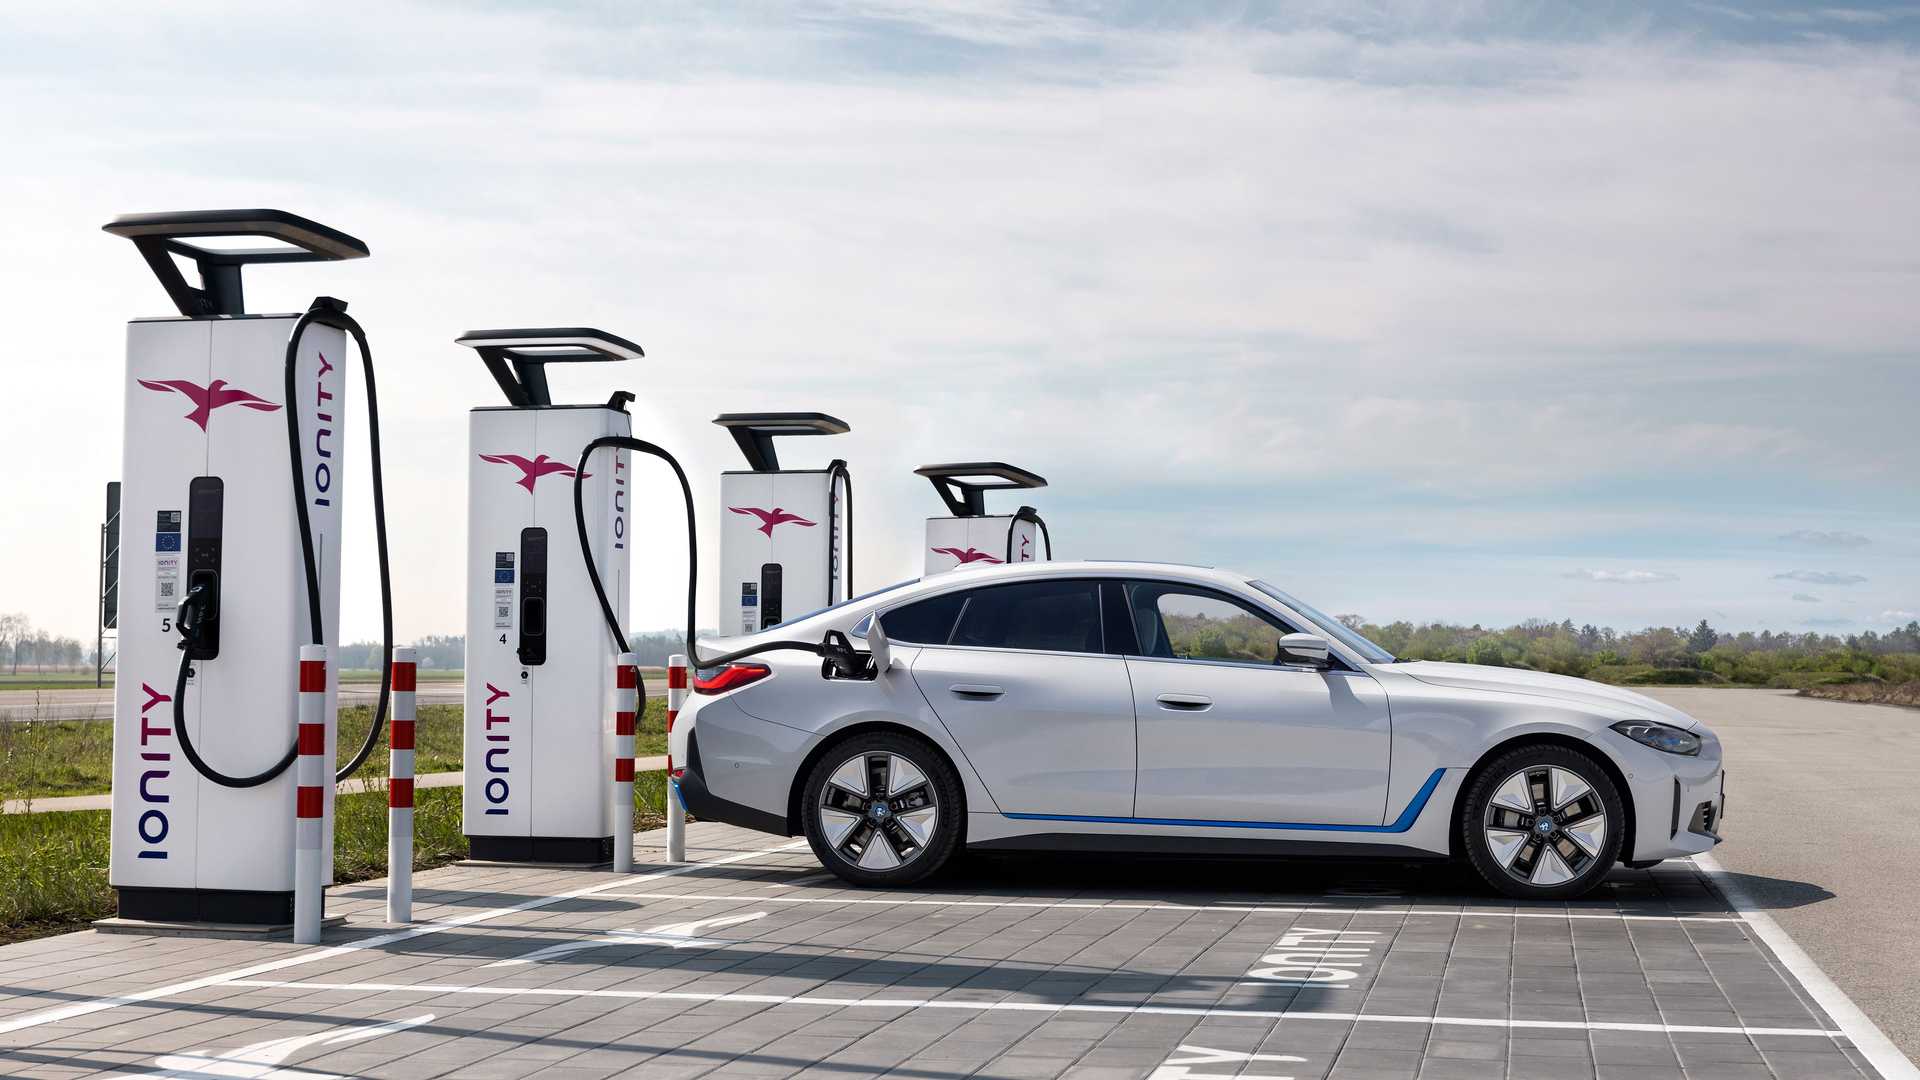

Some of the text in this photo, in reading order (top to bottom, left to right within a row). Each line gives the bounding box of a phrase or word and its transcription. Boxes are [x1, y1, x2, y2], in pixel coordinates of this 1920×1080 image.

[315, 352, 333, 507] IONITY
[161, 617, 171, 632] 5
[499, 633, 507, 645] 4
[137, 683, 172, 859] IONITY
[485, 683, 510, 816] IONITY
[1240, 927, 1382, 989] IONITY
